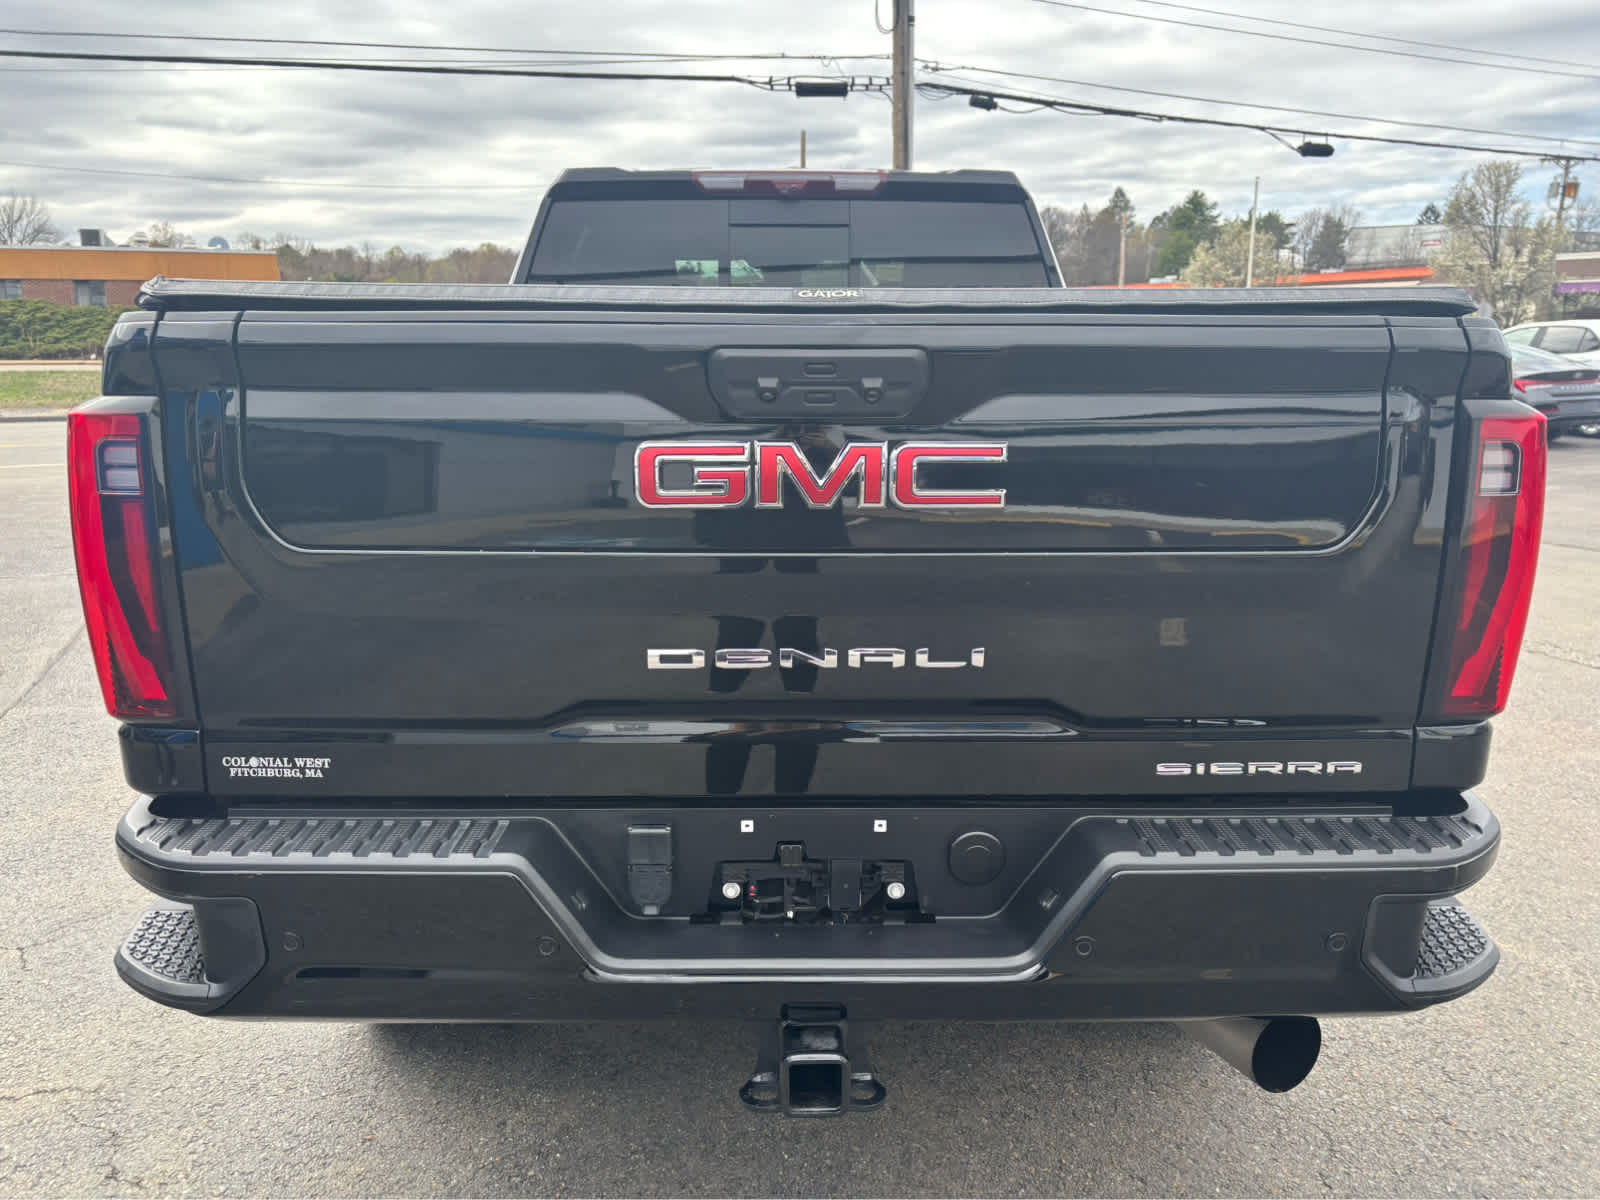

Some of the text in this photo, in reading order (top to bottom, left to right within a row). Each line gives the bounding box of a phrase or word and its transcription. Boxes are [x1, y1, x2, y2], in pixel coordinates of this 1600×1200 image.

[798, 289, 859, 298] GATOR
[634, 440, 1009, 510] GMC
[646, 647, 985, 670] DENALI
[222, 756, 331, 768] COLONIAL WEST
[1155, 761, 1363, 776] SIERRA
[229, 767, 323, 778] FITCHBURG, MA
